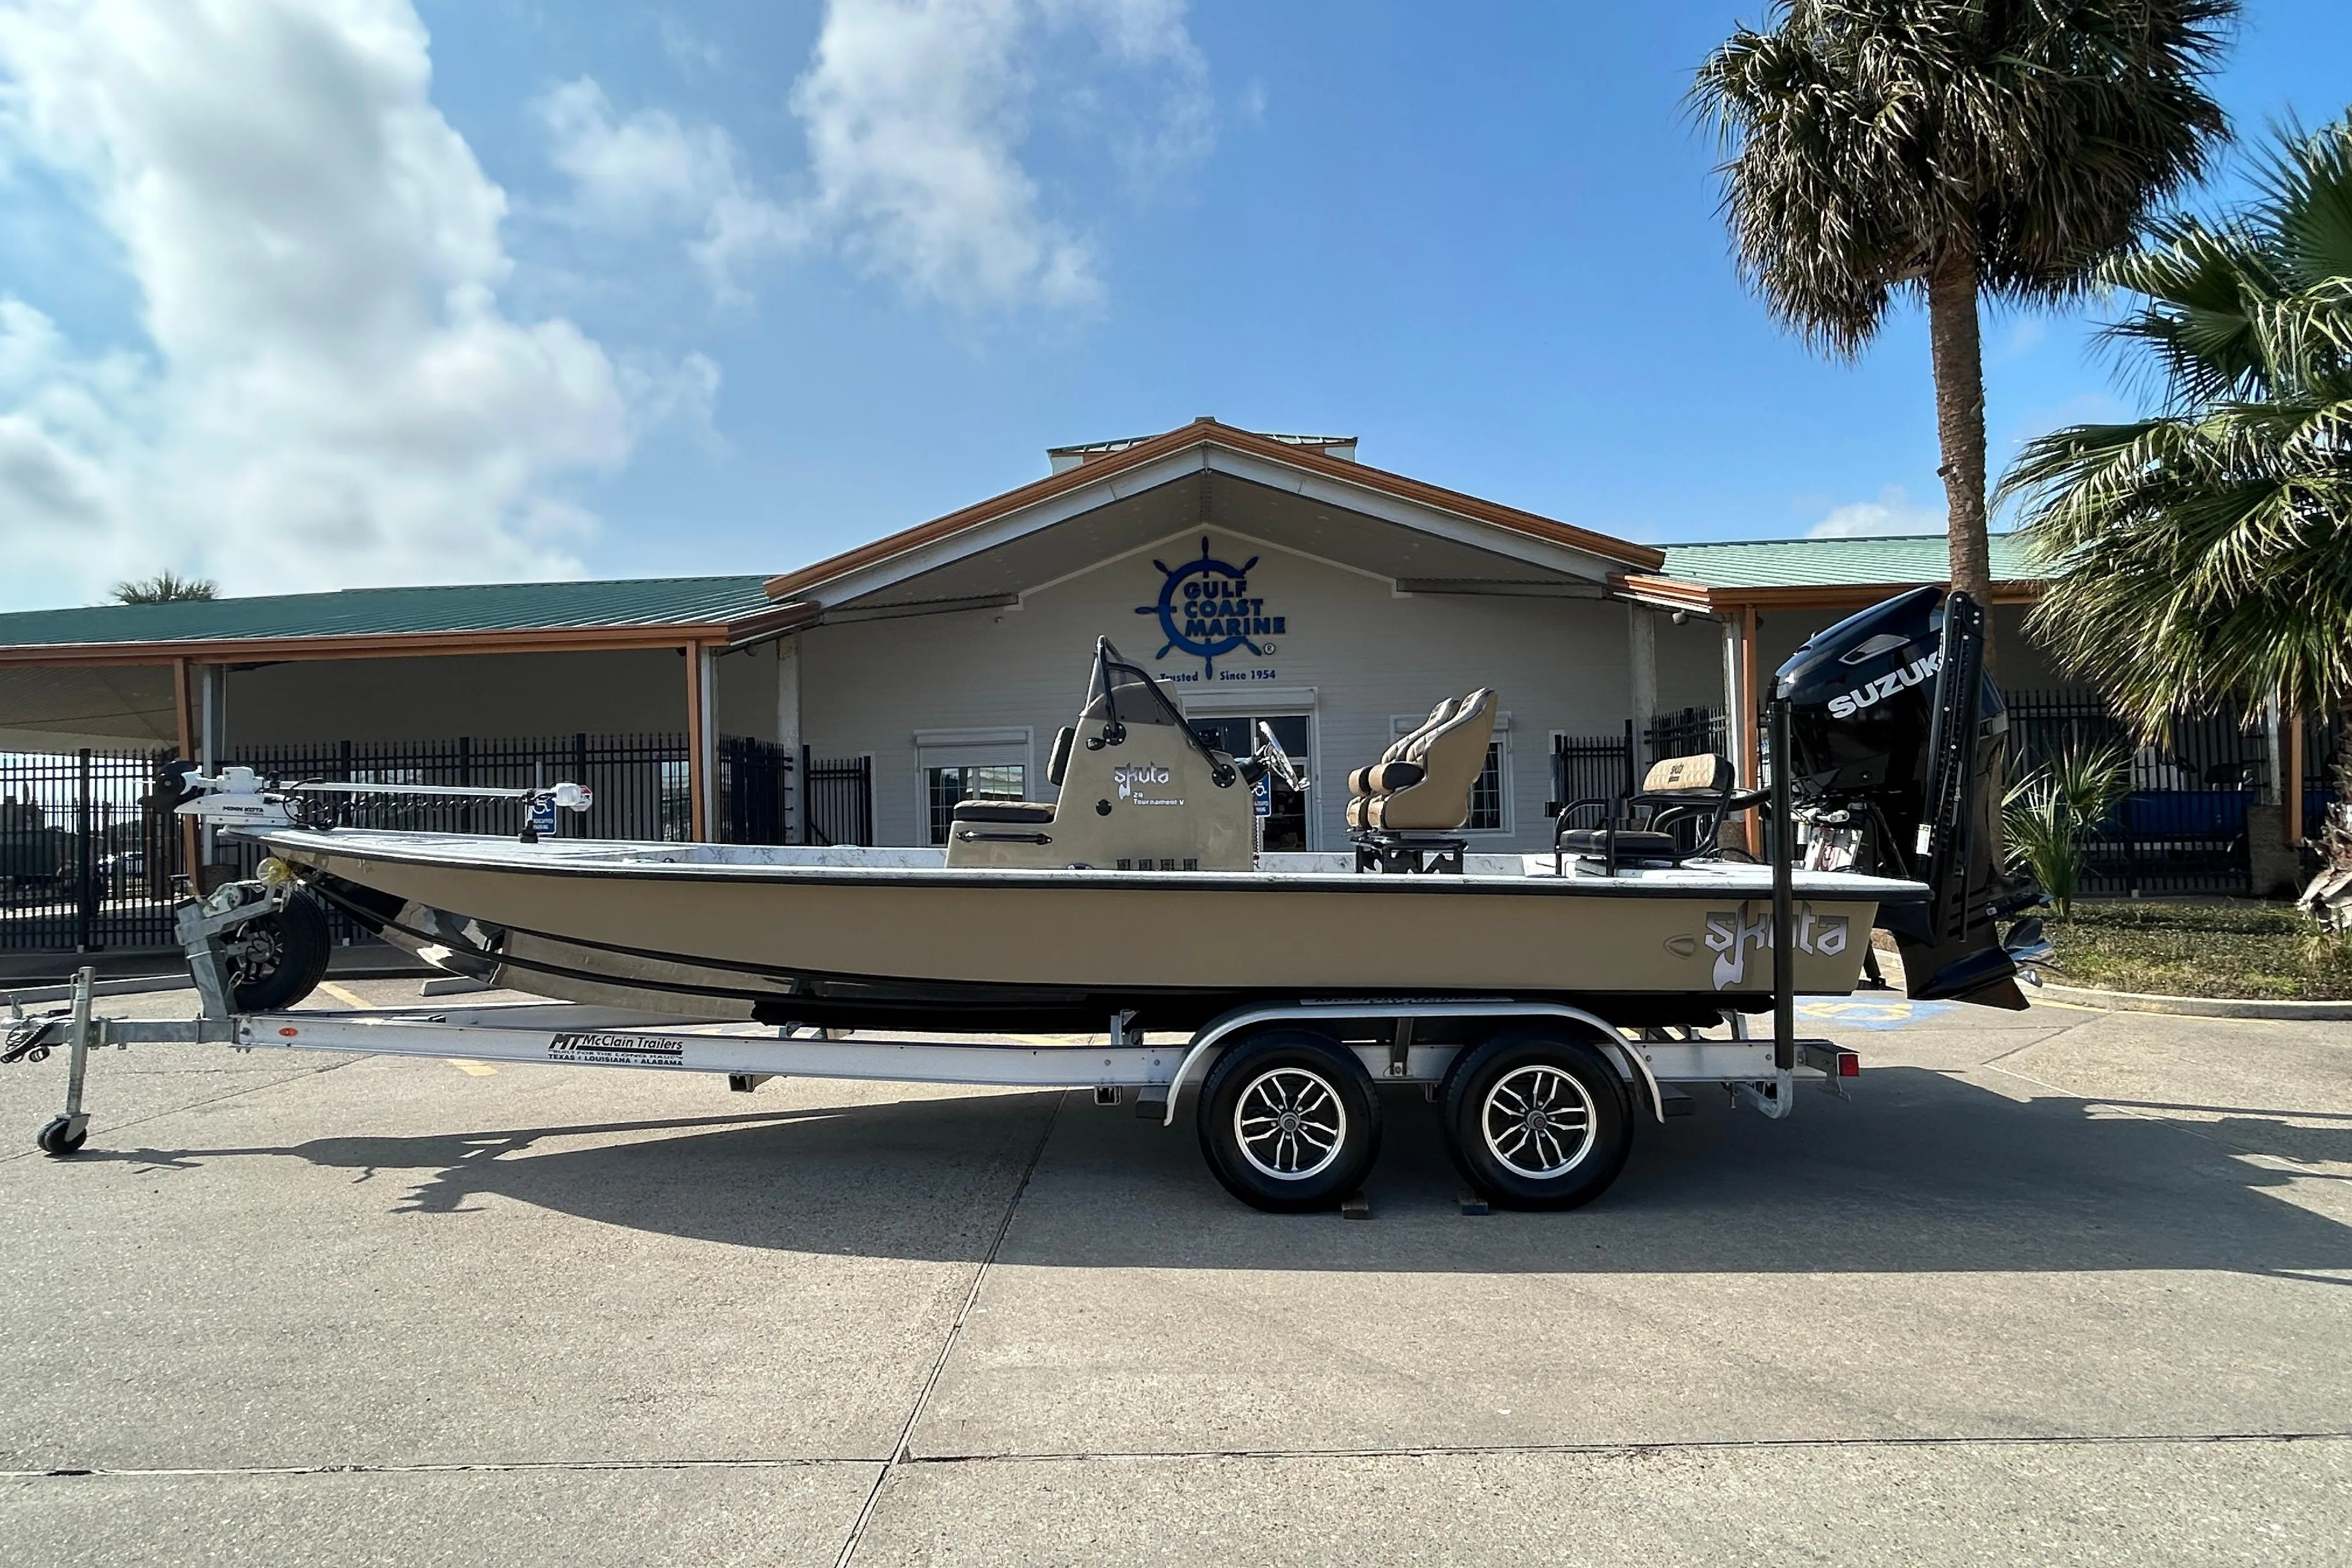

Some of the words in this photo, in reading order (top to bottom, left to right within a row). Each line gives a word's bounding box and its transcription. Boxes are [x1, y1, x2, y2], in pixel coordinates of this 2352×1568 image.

[1183, 580, 1247, 600] GULF
[1184, 598, 1264, 618] COAST
[1185, 617, 1286, 637] MARINE
[1219, 671, 1246, 680] Since
[1251, 670, 1276, 680] 1954
[1828, 650, 1939, 719] SUZUK
[549, 1033, 586, 1050] MT
[582, 1035, 633, 1047] McClain
[638, 1037, 684, 1050] Trailers
